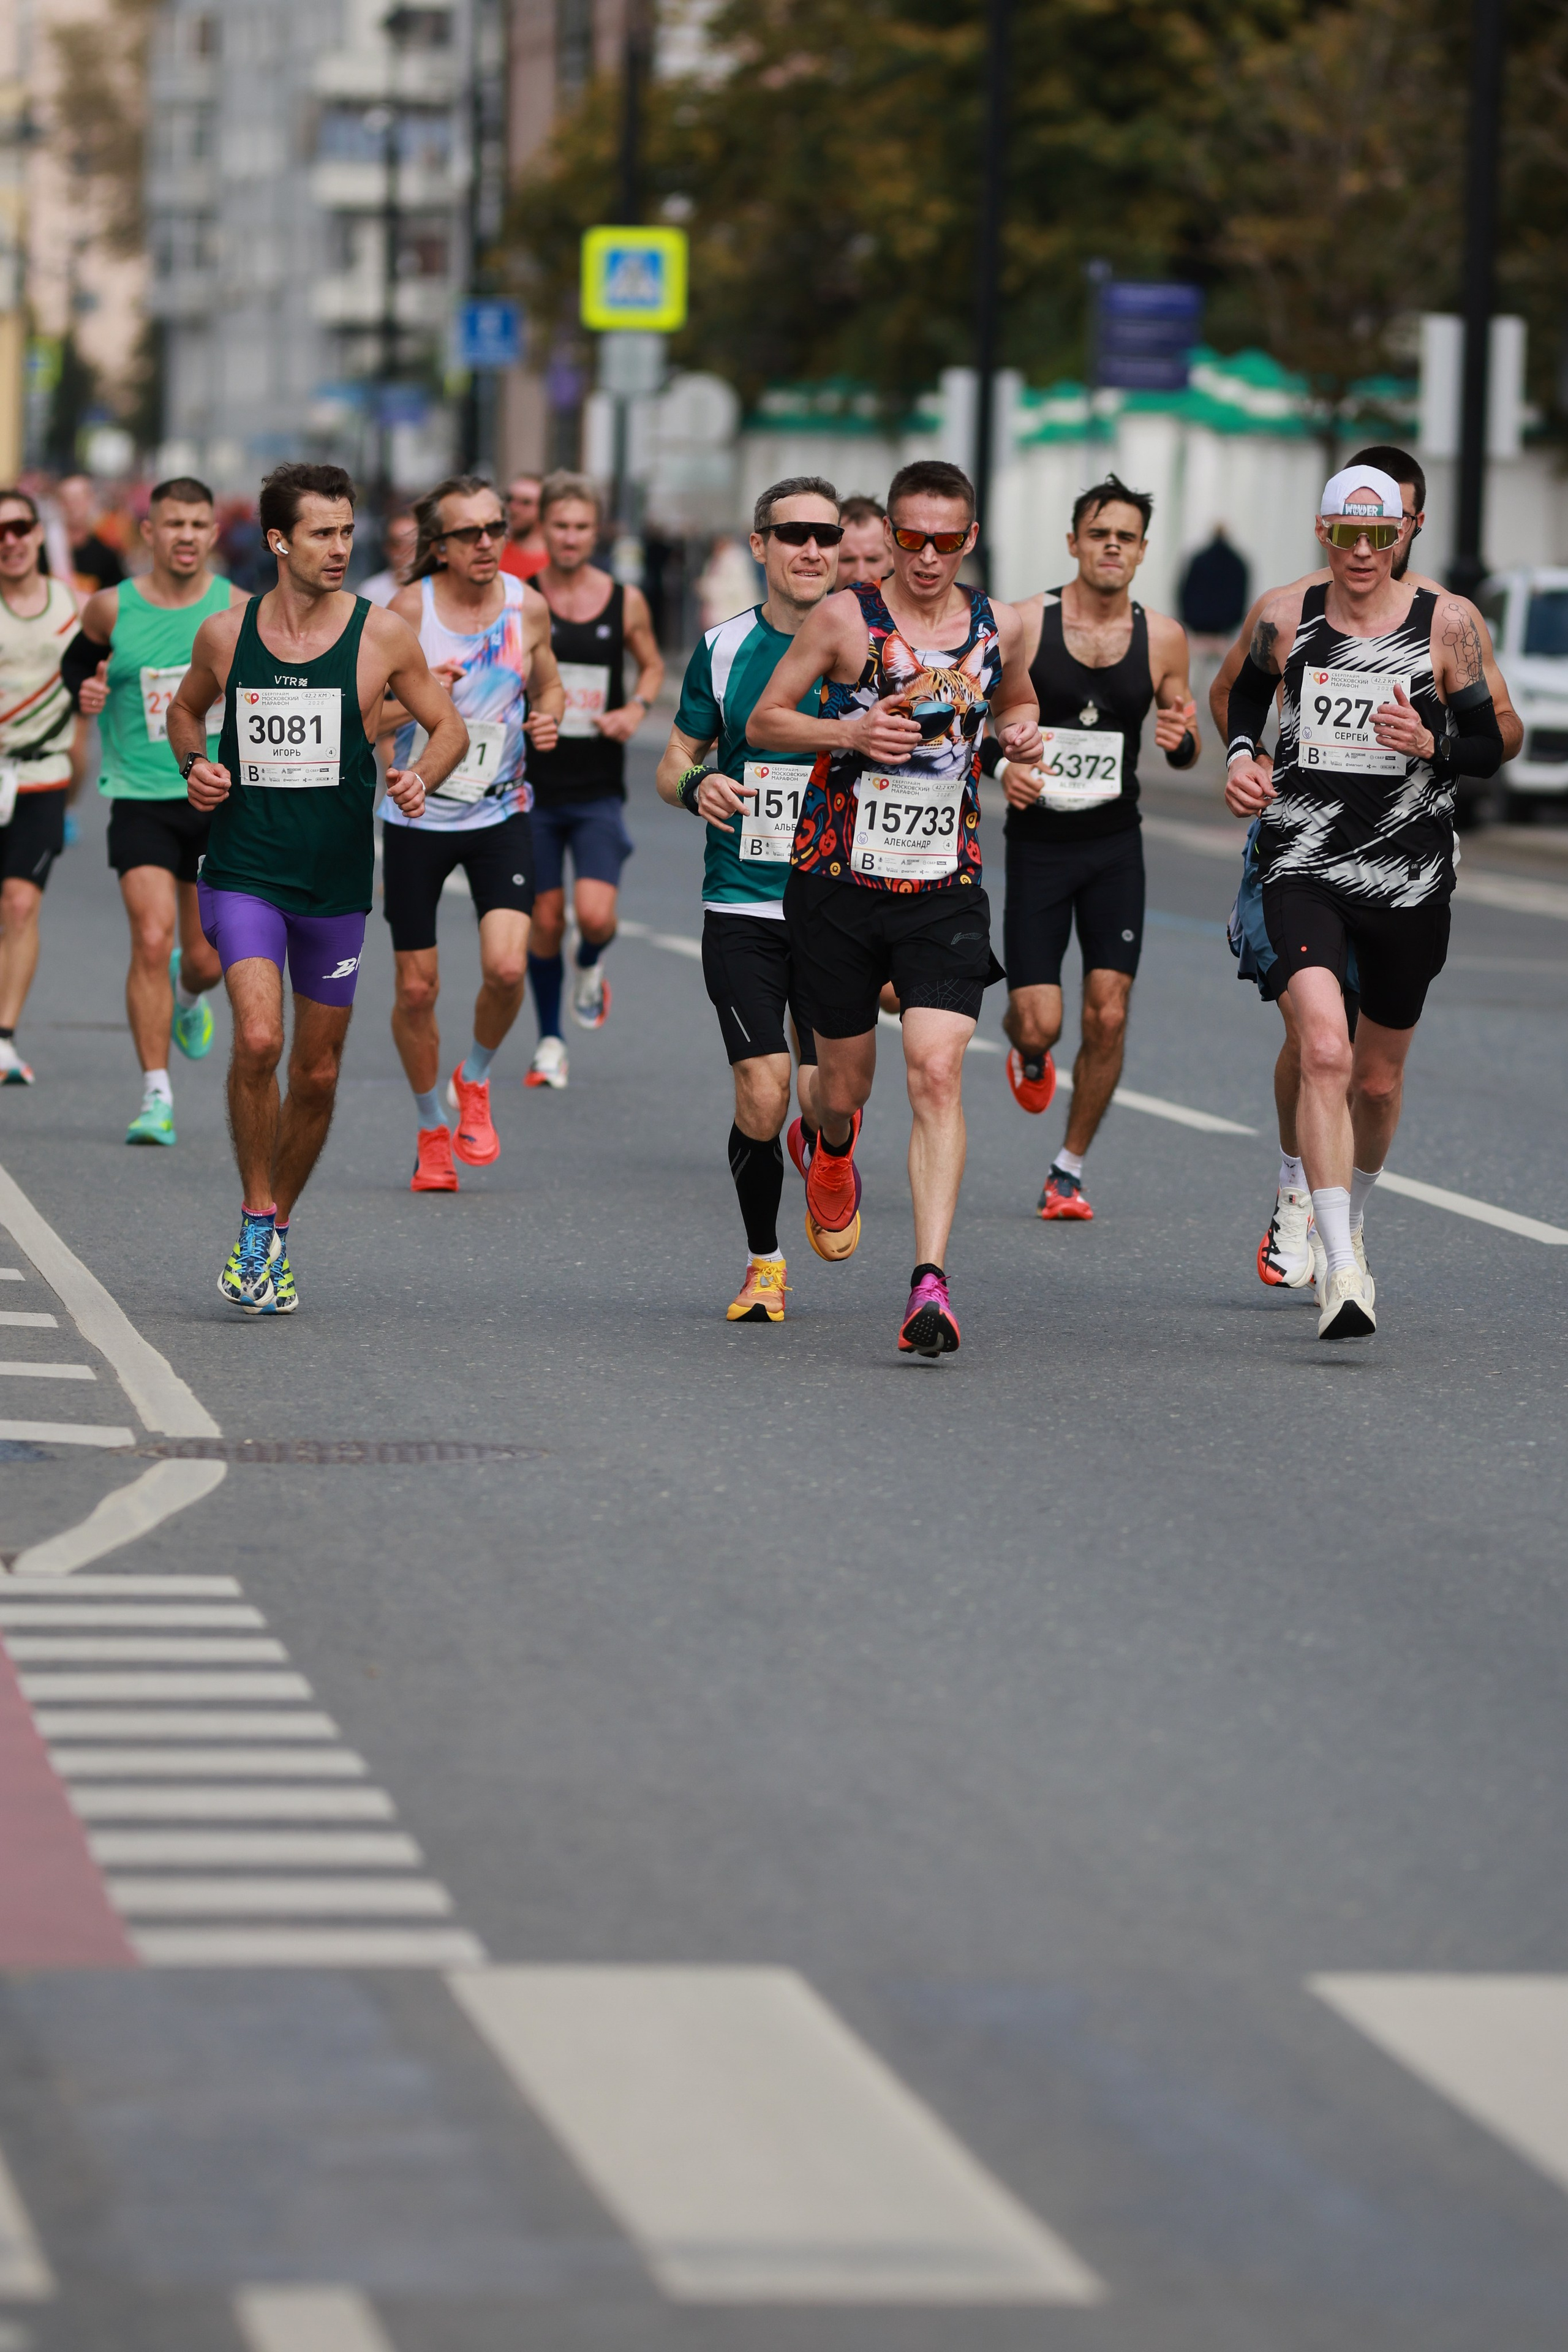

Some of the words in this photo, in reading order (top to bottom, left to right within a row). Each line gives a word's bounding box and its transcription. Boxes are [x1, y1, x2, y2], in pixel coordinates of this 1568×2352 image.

[1345, 503, 1379, 516] WONDER
[1314, 695, 1390, 729] 927
[249, 715, 322, 744] 3081
[1335, 731, 1368, 742] СЕРГЕЙ
[1038, 752, 1116, 780] 6372
[892, 783, 930, 792] МОСКОВСКИЙ
[754, 788, 799, 819] 151
[864, 800, 956, 836] 15733
[884, 837, 931, 849] АЛЕКСАНДР
[322, 947, 362, 979] B
